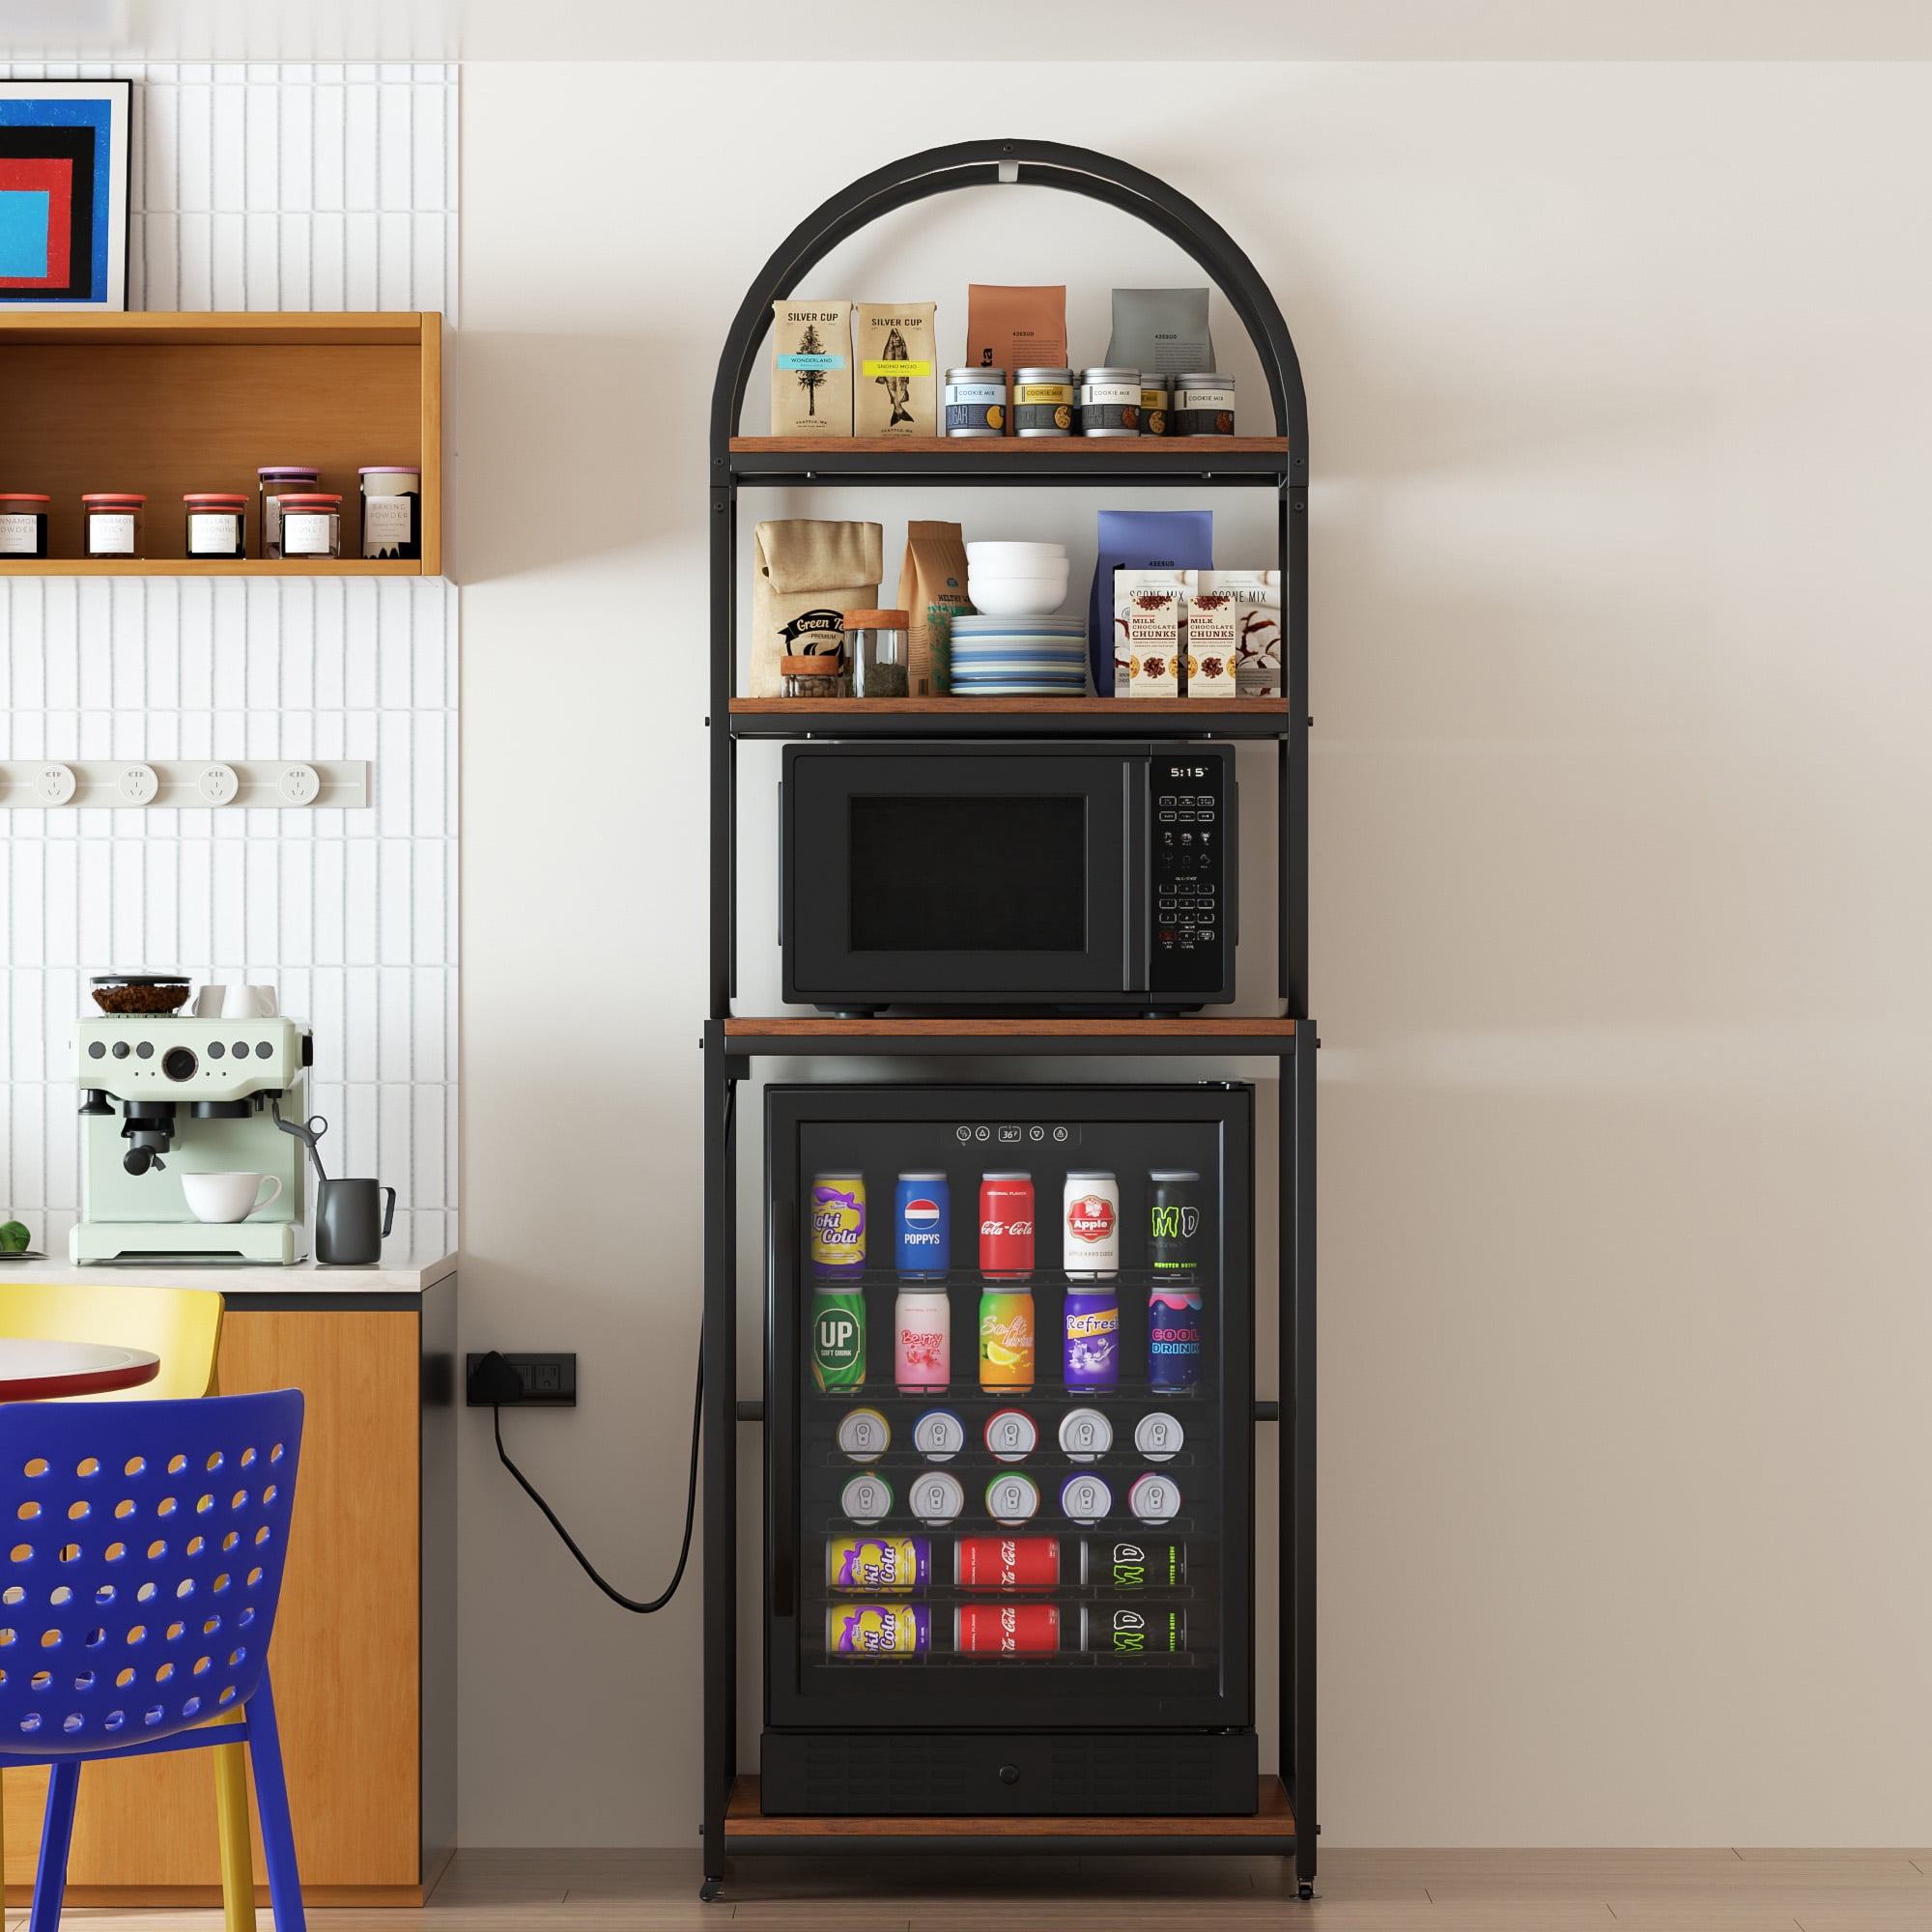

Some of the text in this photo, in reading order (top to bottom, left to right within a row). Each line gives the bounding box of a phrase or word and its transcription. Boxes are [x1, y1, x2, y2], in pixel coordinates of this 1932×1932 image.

[787, 313, 838, 322] SILVER CUP
[1248, 590, 1266, 603] MIX
[797, 618, 843, 632] Green Te
[1171, 767, 1204, 778] 5:15
[1073, 1219, 1108, 1231] Apple
[821, 1228, 858, 1244] Cola
[904, 1233, 940, 1245] POPPYS
[980, 1315, 1028, 1346] Soft
[1066, 1314, 1119, 1333] Refresh
[821, 1321, 853, 1349] UP
[901, 1329, 943, 1349] Berry
[1151, 1328, 1200, 1342] COOL
[1151, 1342, 1200, 1354] DRINK
[880, 1547, 897, 1583] Cola
[880, 1613, 897, 1650] Cola
